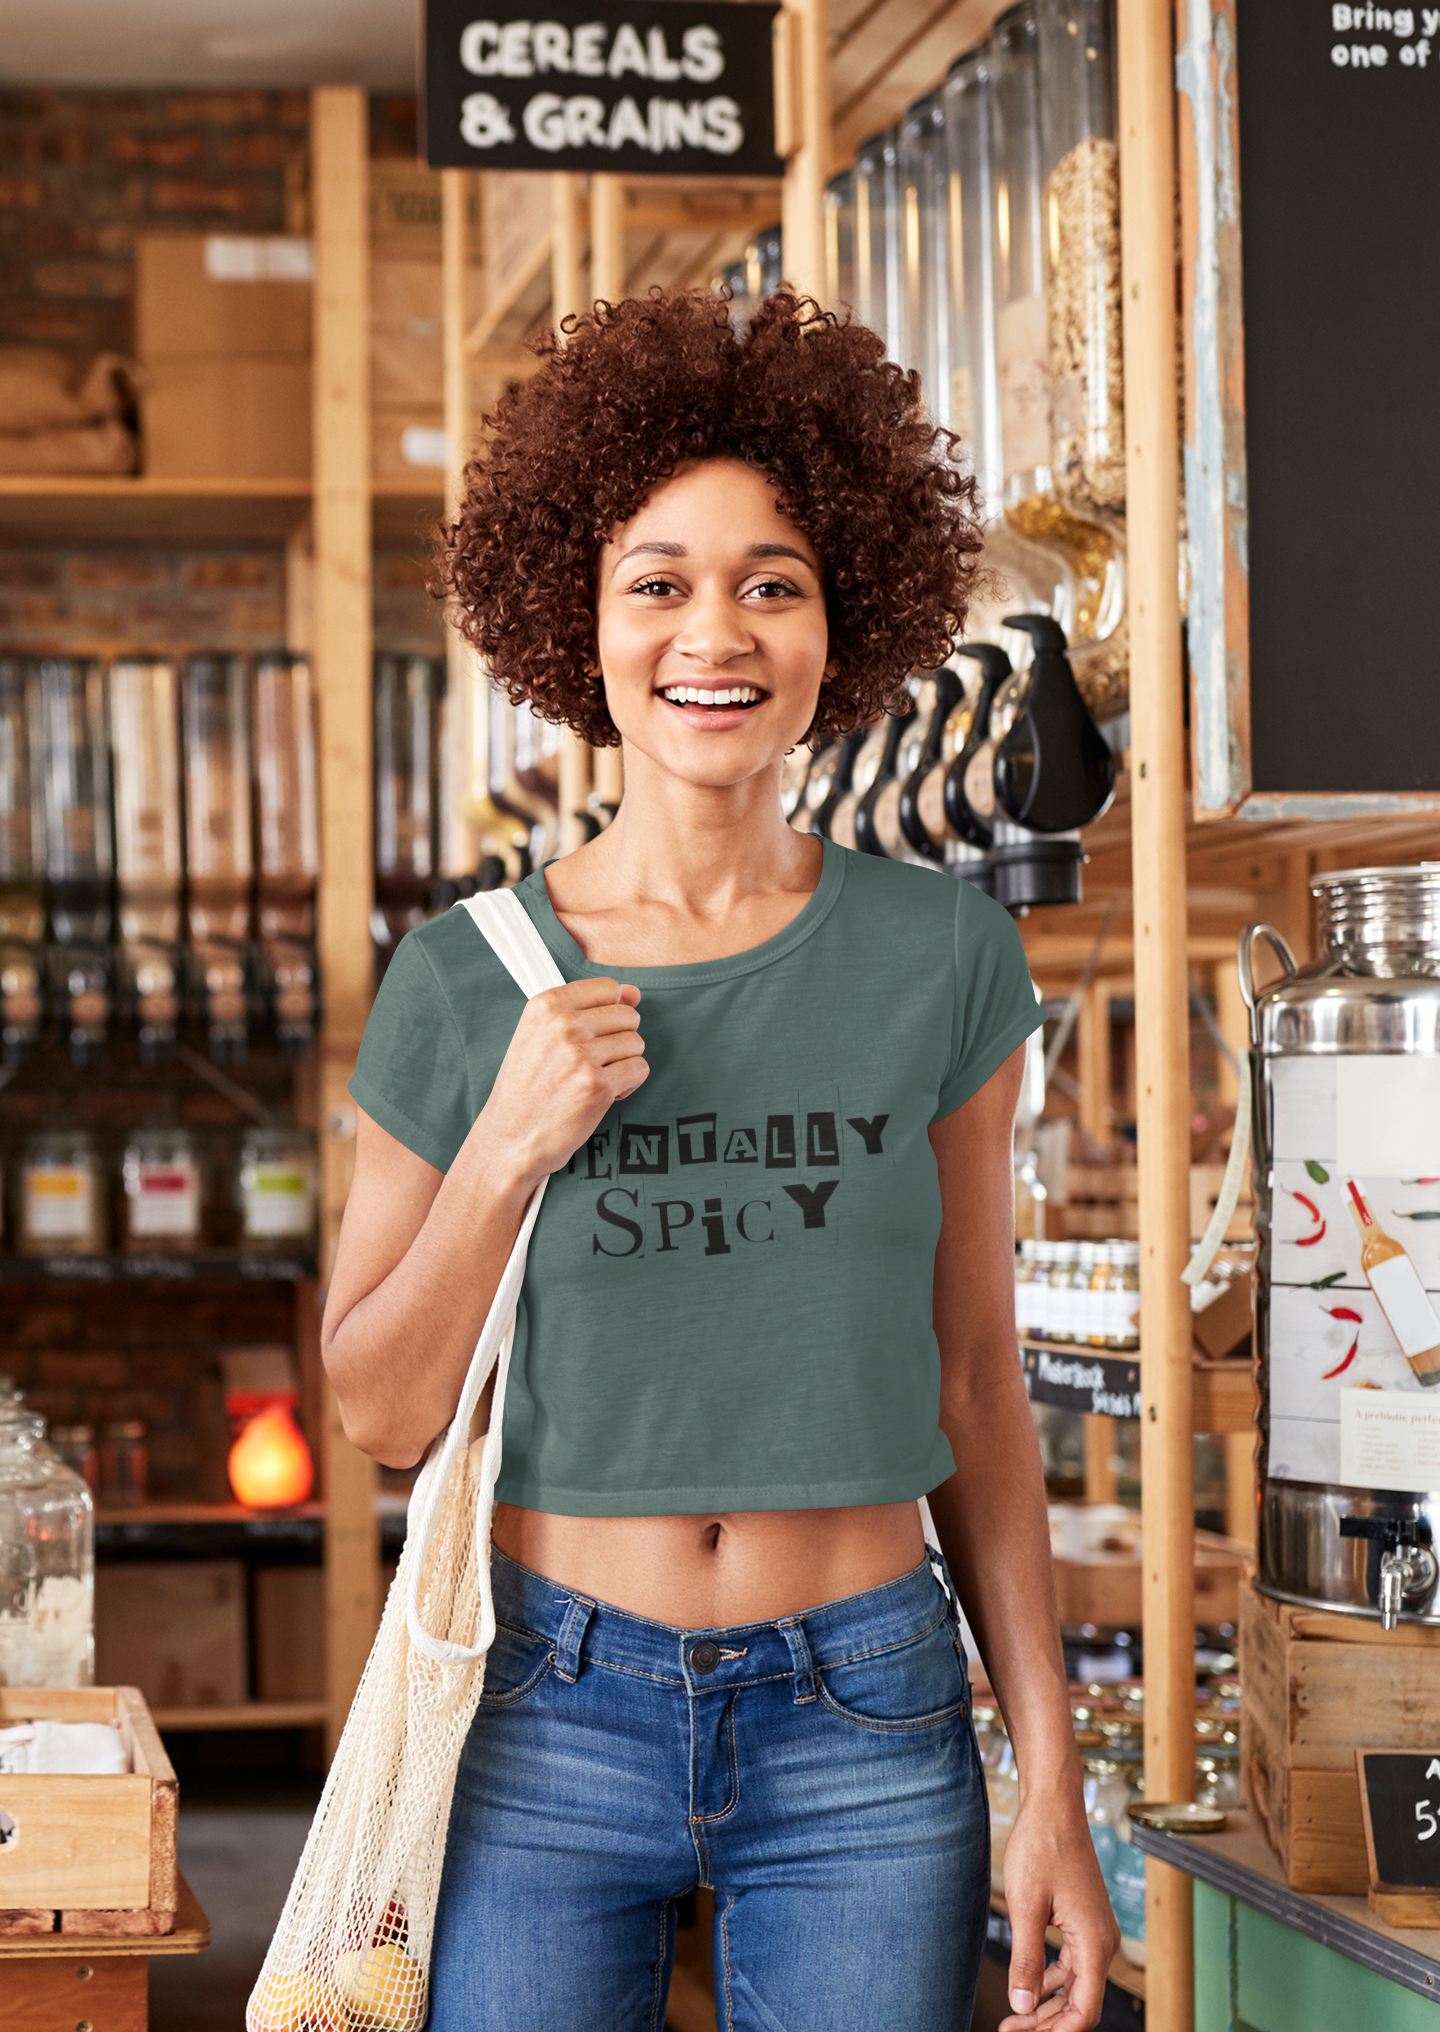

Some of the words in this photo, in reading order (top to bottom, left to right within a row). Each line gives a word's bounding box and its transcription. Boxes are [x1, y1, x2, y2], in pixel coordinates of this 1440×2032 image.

[1332, 0, 1415, 38] Bring
[460, 19, 724, 82] CEREALS
[1330, 43, 1389, 68] one
[1398, 37, 1432, 69] of
[460, 91, 516, 148] &
[523, 91, 744, 155] GRAINS
[553, 1112, 891, 1181] ENTALLY
[1364, 1410, 1407, 1423] prebiotic
